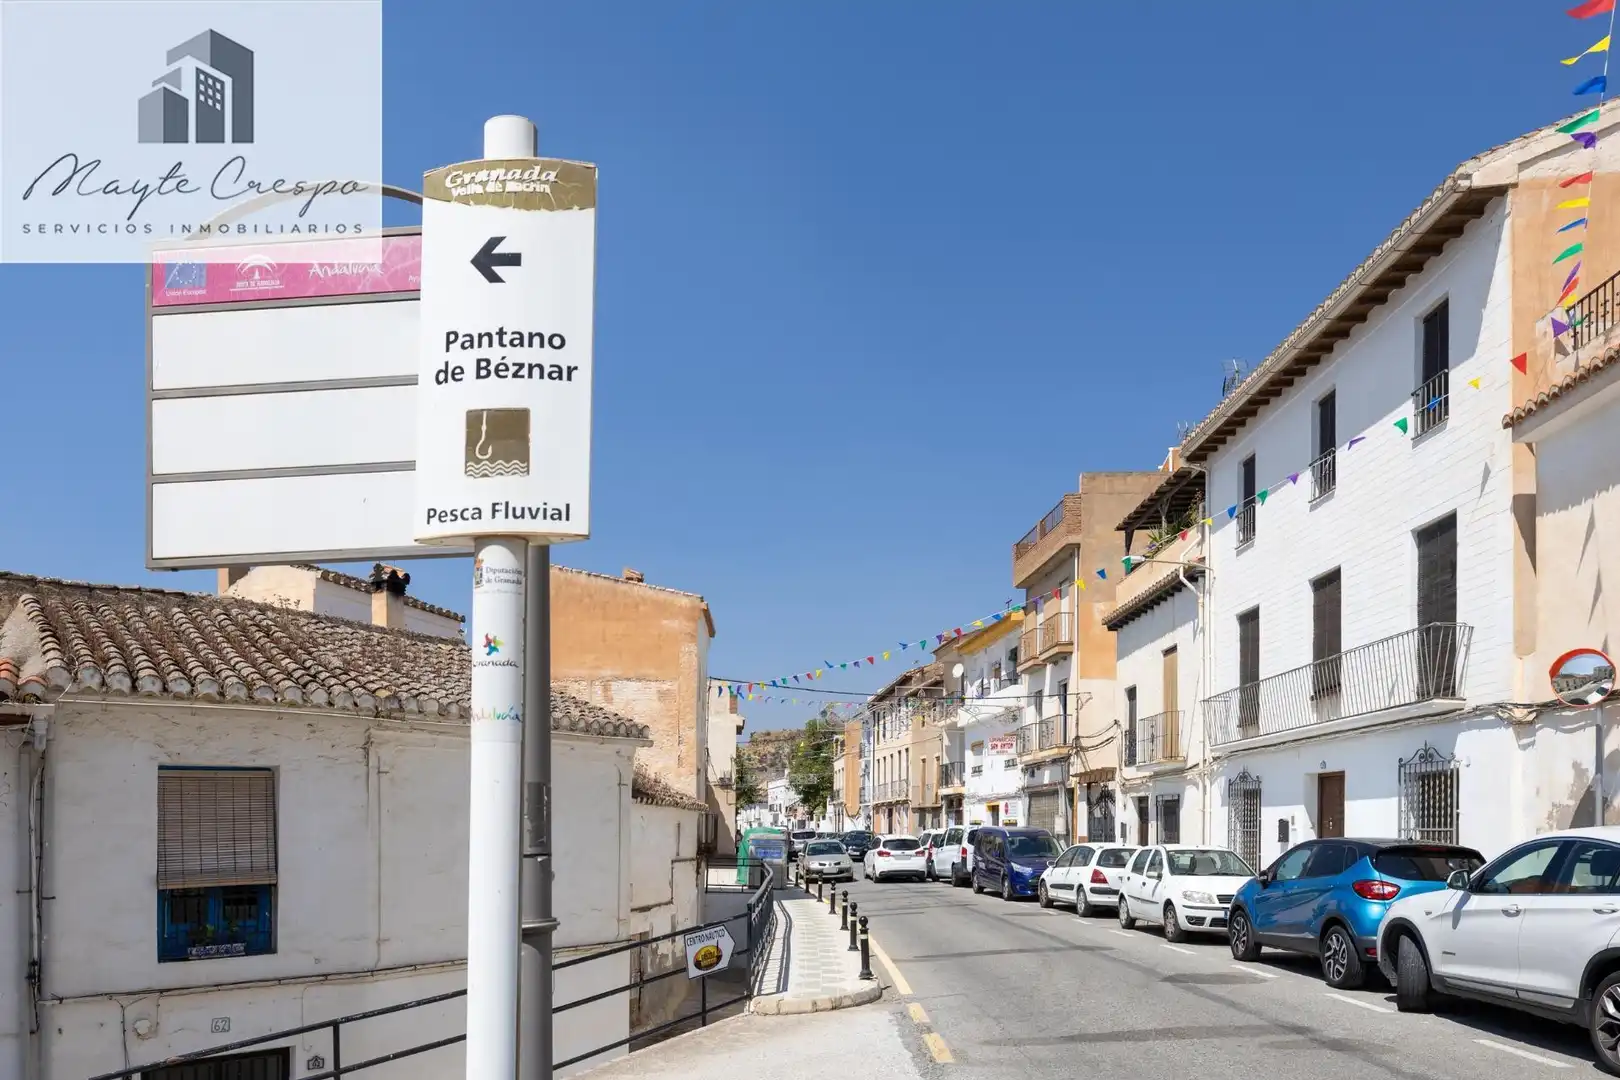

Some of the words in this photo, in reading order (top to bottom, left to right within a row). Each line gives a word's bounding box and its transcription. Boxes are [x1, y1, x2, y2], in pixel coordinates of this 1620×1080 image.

[445, 164, 558, 188] Granada
[445, 326, 566, 353] Pantano
[435, 361, 465, 386] de
[475, 356, 579, 382] Béznar
[426, 507, 483, 525] Pesca
[491, 501, 571, 522] Fluvial
[494, 577, 522, 585] Granada
[214, 1020, 227, 1031] 62
